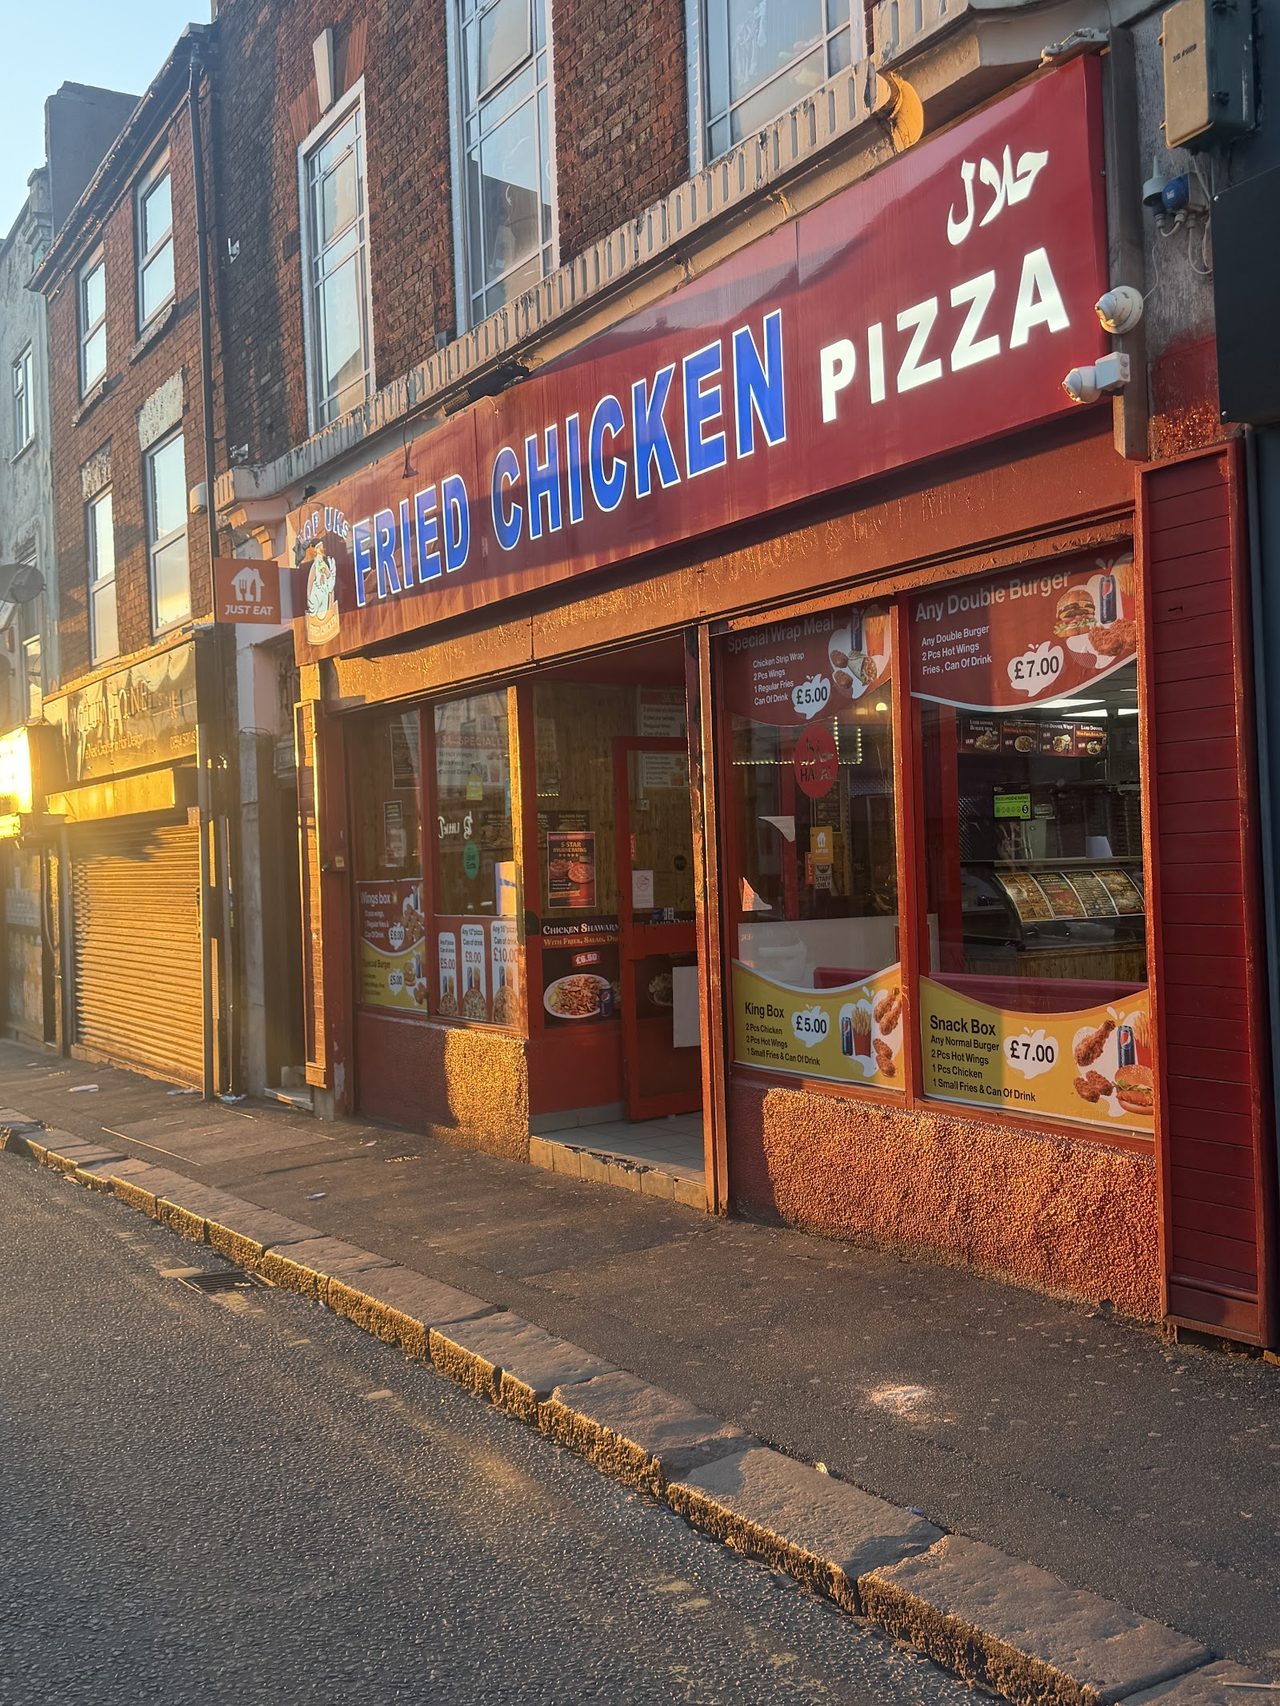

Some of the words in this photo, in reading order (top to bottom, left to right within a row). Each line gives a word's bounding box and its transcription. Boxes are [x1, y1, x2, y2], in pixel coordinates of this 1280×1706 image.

[947, 144, 1049, 245] حلال
[352, 474, 470, 608] FRIED
[491, 308, 786, 551] CHICKEN
[820, 247, 1070, 424] PIZZA
[915, 600, 944, 623] Any
[947, 587, 1005, 615] Double
[1009, 571, 1071, 601] Burger
[224, 605, 251, 616] JUST
[252, 606, 273, 616] EAT
[727, 630, 770, 654] Special
[770, 626, 801, 645] Wrap
[803, 614, 834, 636] Meal
[921, 637, 936, 648] Any
[936, 631, 962, 644] Double
[964, 625, 990, 638] Burger
[753, 658, 776, 669] Chicken
[776, 655, 789, 666] Strip
[788, 652, 805, 664] Wrap
[921, 652, 927, 661] 2
[927, 650, 941, 660] Pcs
[942, 646, 955, 657] Hot
[955, 642, 980, 655] Wings
[944, 663, 960, 672] Can
[961, 659, 970, 669] Of
[971, 654, 992, 666] Drink
[1013, 655, 1060, 680] £7.00
[757, 672, 768, 680] Pcs
[768, 669, 786, 679] Wings
[758, 682, 778, 693] Regular
[779, 680, 794, 689] Fries
[796, 686, 828, 705] £5.00
[754, 697, 765, 706] Can
[773, 693, 788, 702] Drink
[575, 953, 598, 965] £6.50
[744, 1002, 765, 1019] King
[766, 1004, 785, 1019] Box
[750, 1024, 760, 1032] Pcs
[760, 1025, 783, 1035] Chicken
[795, 1015, 828, 1034] £5.00
[930, 1015, 969, 1033] Snack
[971, 1018, 996, 1036] Box
[750, 1036, 760, 1045] Pcs
[760, 1038, 771, 1046] Hot
[771, 1039, 788, 1049] Wings
[930, 1035, 945, 1046] Any
[945, 1037, 973, 1049] Normal
[973, 1040, 1000, 1052] Burger
[1009, 1039, 1055, 1063] £7.00
[750, 1048, 766, 1058] Small
[766, 1050, 780, 1060] Fries
[784, 1054, 798, 1062] Can
[804, 1056, 820, 1066] Drink
[931, 1049, 936, 1058] 2
[936, 1050, 951, 1061] Pcs
[951, 1052, 964, 1063] Hot
[965, 1053, 989, 1066] Wings
[938, 1065, 951, 1075] Pcs
[952, 1067, 983, 1079] Chicken
[938, 1079, 958, 1090] Small
[959, 1081, 978, 1093] Fries
[979, 1085, 985, 1094] &
[986, 1086, 1002, 1097] Can
[1003, 1088, 1013, 1098] Of
[1013, 1090, 1036, 1102] Drink
